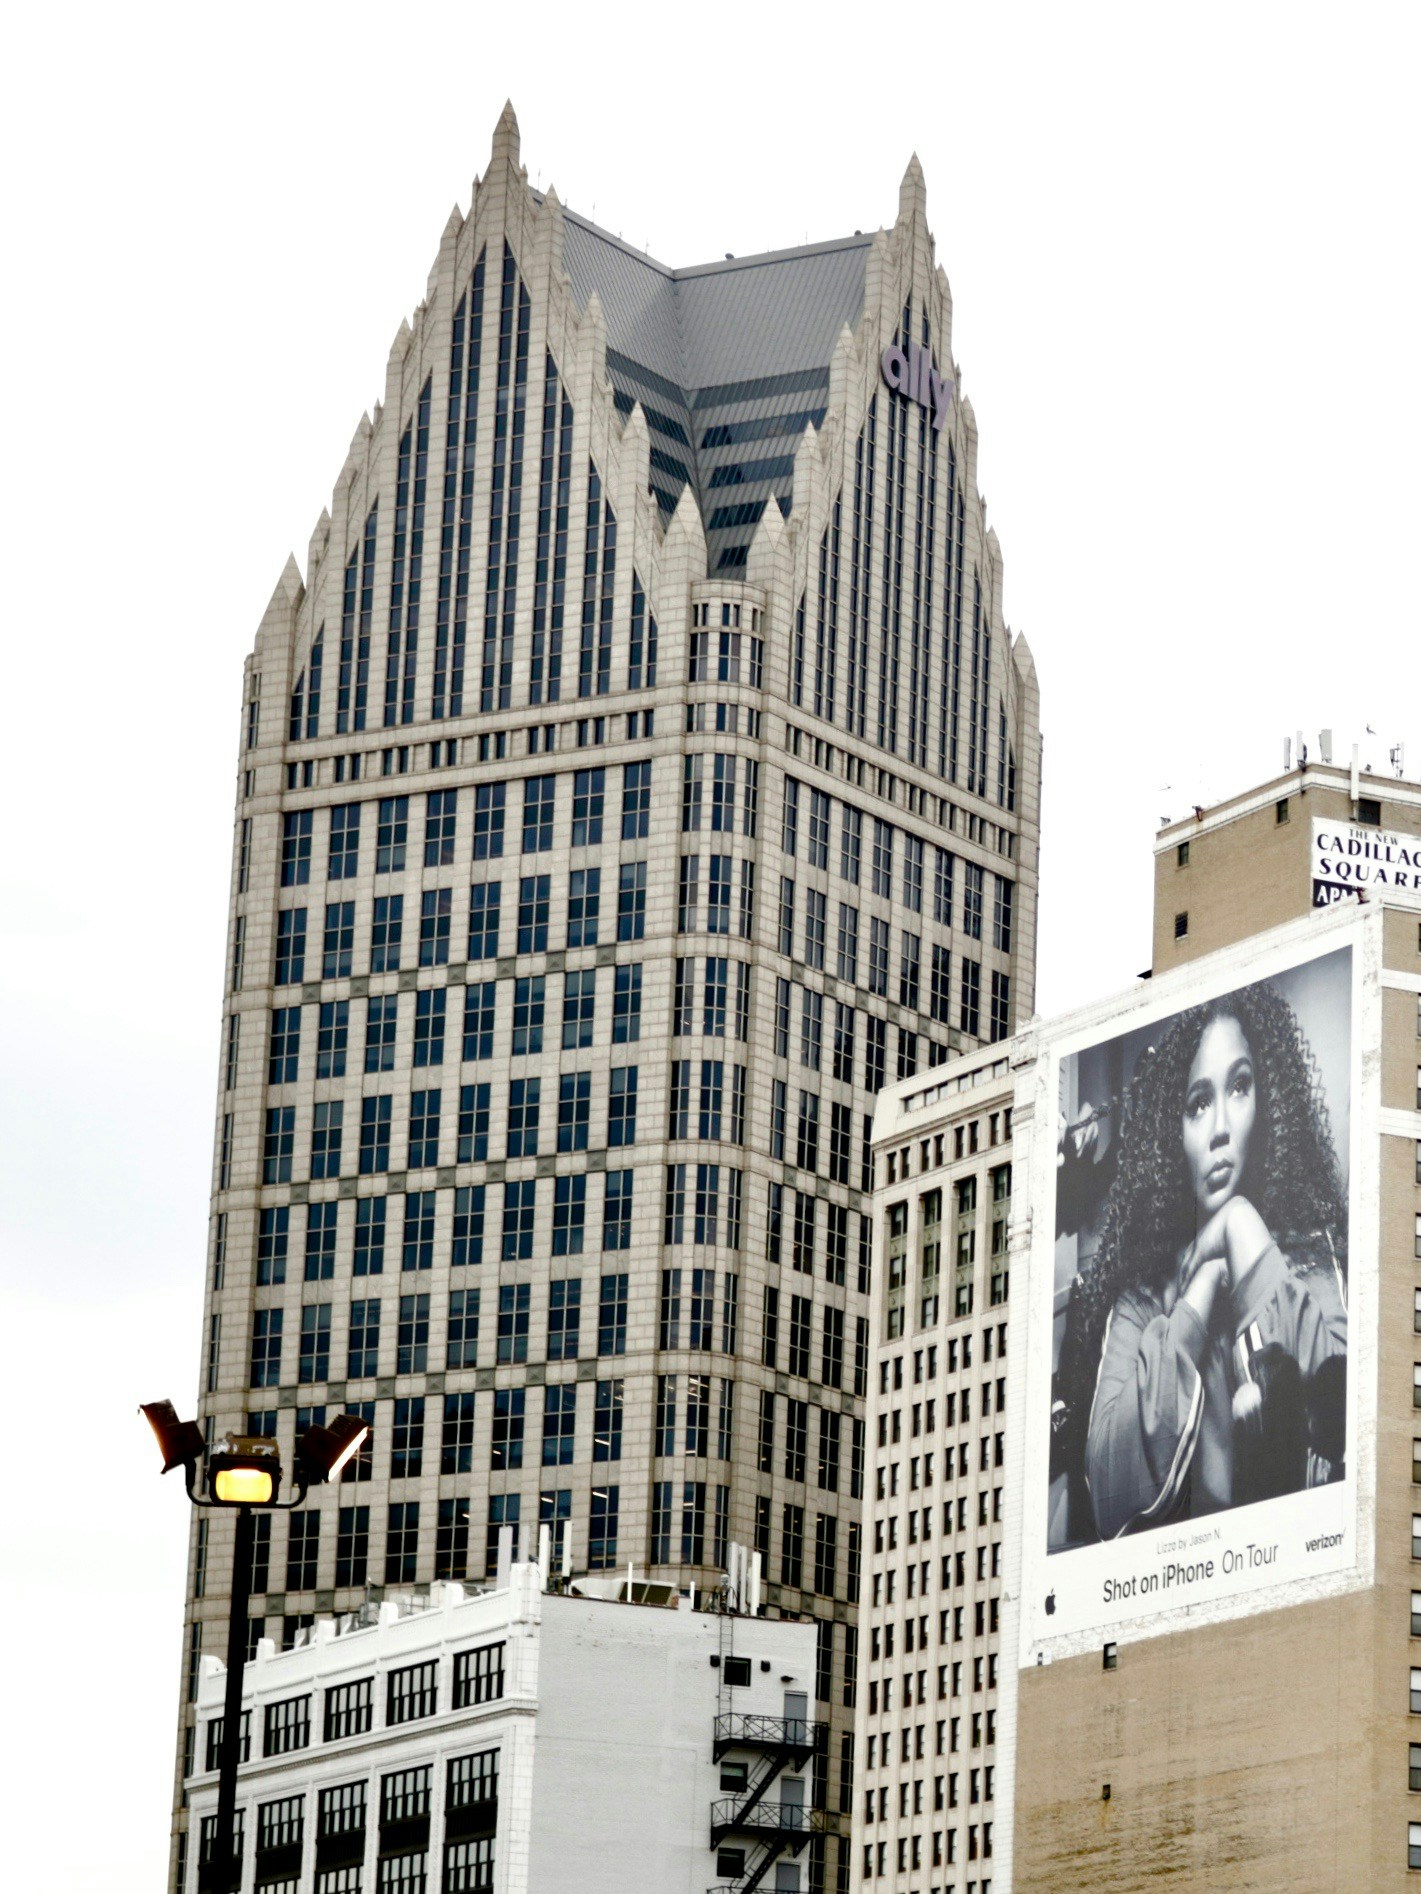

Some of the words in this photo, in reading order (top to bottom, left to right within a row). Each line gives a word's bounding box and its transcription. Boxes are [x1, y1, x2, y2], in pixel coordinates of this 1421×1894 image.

[881, 340, 954, 431] ally
[1349, 828, 1368, 840] THE
[1376, 833, 1399, 846] NEW
[1156, 1541, 1176, 1555] Lizzo
[1178, 1538, 1188, 1551] by
[1189, 1534, 1212, 1546] Jason
[1305, 1533, 1342, 1552] verizon
[1103, 1575, 1137, 1602] Shot
[1140, 1574, 1158, 1594] on
[1162, 1560, 1214, 1589] iPhone
[1222, 1549, 1243, 1574] On
[1246, 1544, 1279, 1568] Tour
